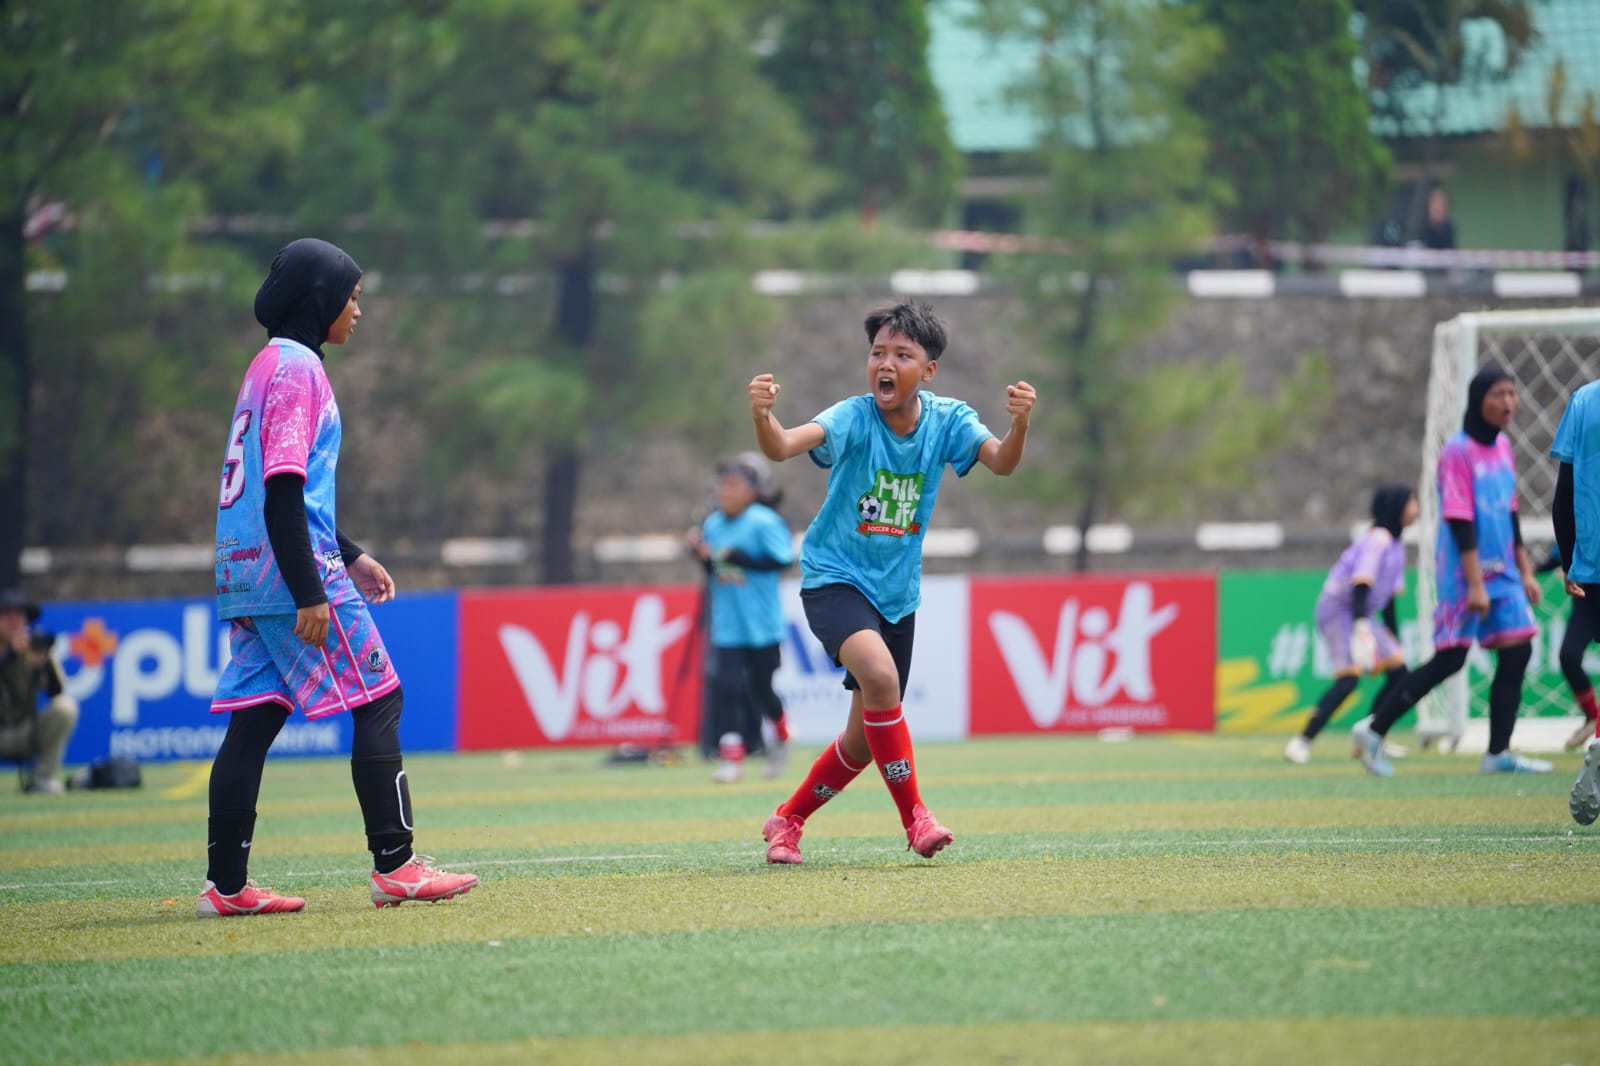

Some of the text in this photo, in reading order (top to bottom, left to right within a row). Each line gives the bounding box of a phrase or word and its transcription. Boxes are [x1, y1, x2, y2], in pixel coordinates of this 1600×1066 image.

[219, 409, 252, 510] 5
[878, 475, 921, 501] Milk
[866, 525, 890, 534] SOCCER
[498, 594, 688, 741] Vit
[988, 581, 1179, 727] Vit
